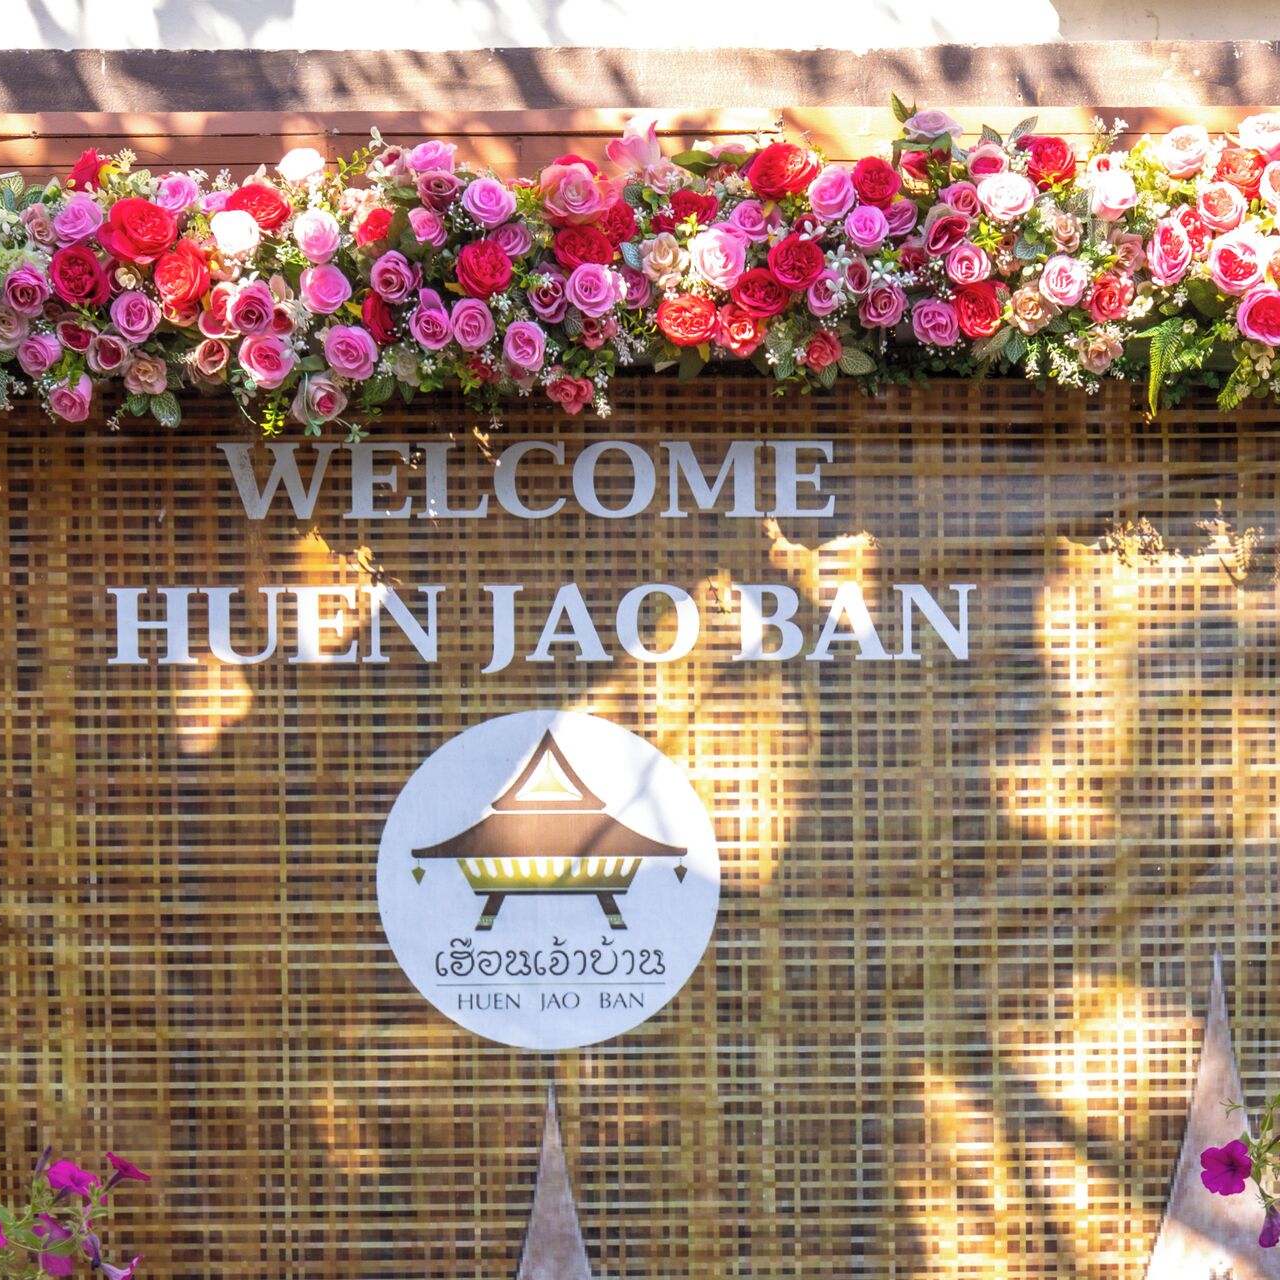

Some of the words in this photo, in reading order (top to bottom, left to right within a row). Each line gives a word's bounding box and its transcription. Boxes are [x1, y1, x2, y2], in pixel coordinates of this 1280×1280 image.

[216, 440, 836, 519] WELCOME
[106, 586, 447, 665] HUEN
[481, 582, 701, 674] JAO
[730, 583, 977, 661] BAN
[435, 935, 666, 977] เฮือนเจ้าบ้าน
[457, 992, 521, 1010] HUEN
[540, 992, 580, 1012] JAO
[599, 991, 644, 1009] BAN
